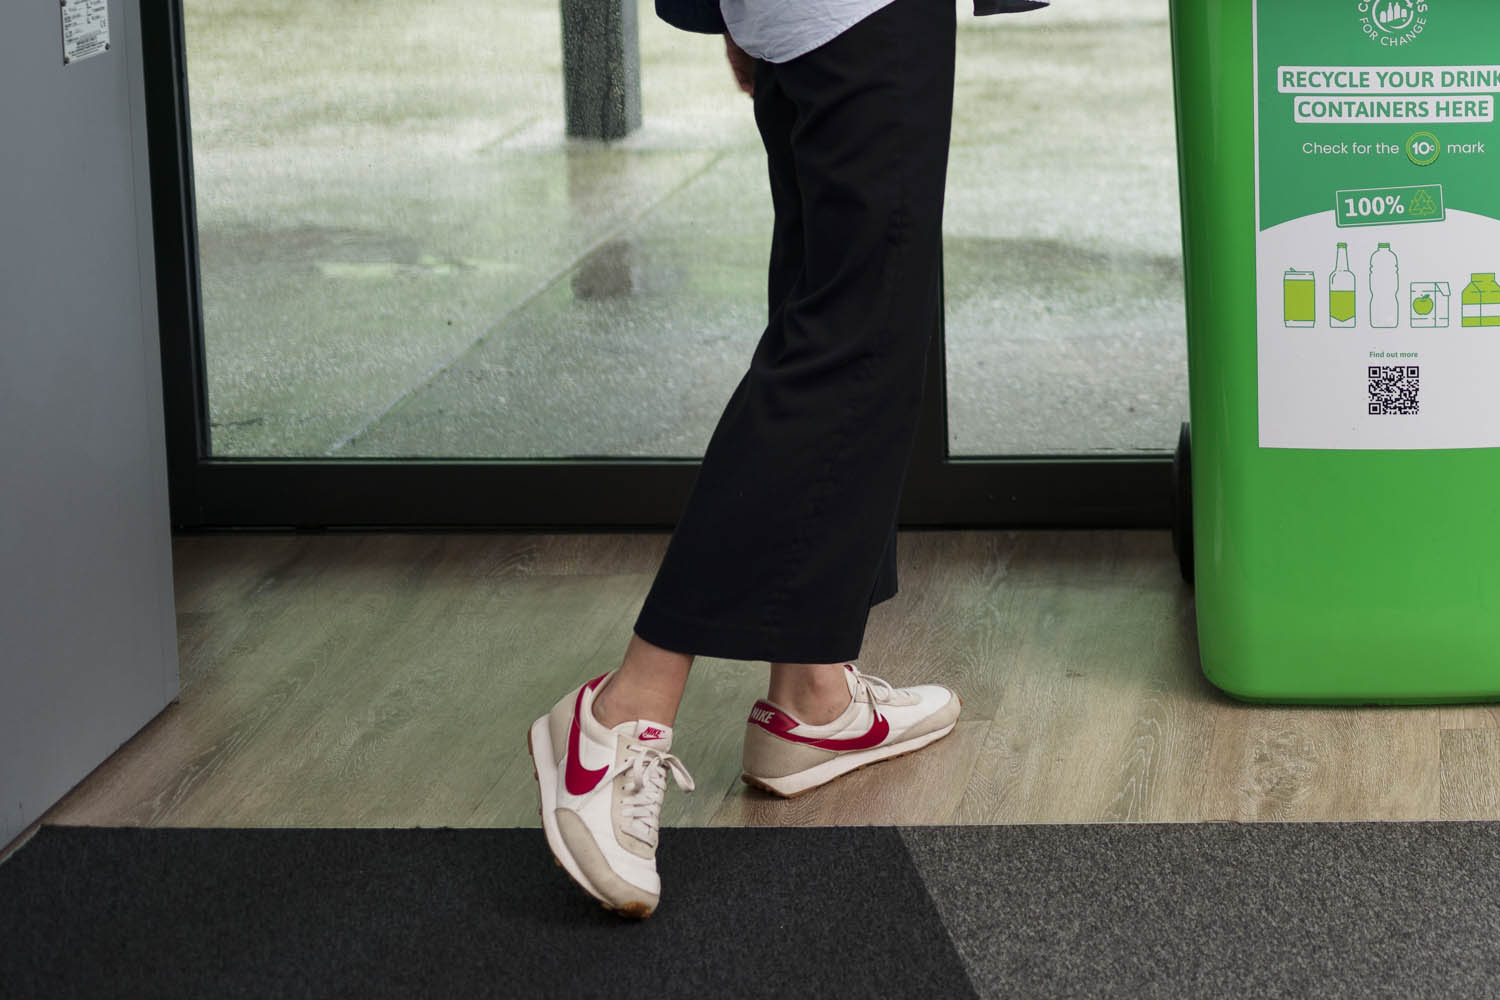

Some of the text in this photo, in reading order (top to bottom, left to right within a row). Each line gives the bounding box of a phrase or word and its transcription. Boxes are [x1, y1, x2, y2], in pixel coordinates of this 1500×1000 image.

[1360, 16, 1427, 47] FOR CHANGE
[1281, 70, 1371, 88] RECYCLE
[1375, 70, 1434, 88] YOUR
[1297, 100, 1489, 119] CONTAINERS HERE
[1302, 141, 1348, 155] Check
[1352, 141, 1373, 155] for
[1375, 141, 1400, 155] the
[1447, 141, 1486, 154] mark
[1344, 195, 1405, 217] 100%
[1369, 351, 1418, 359] Find out more
[750, 707, 775, 724] NIKE
